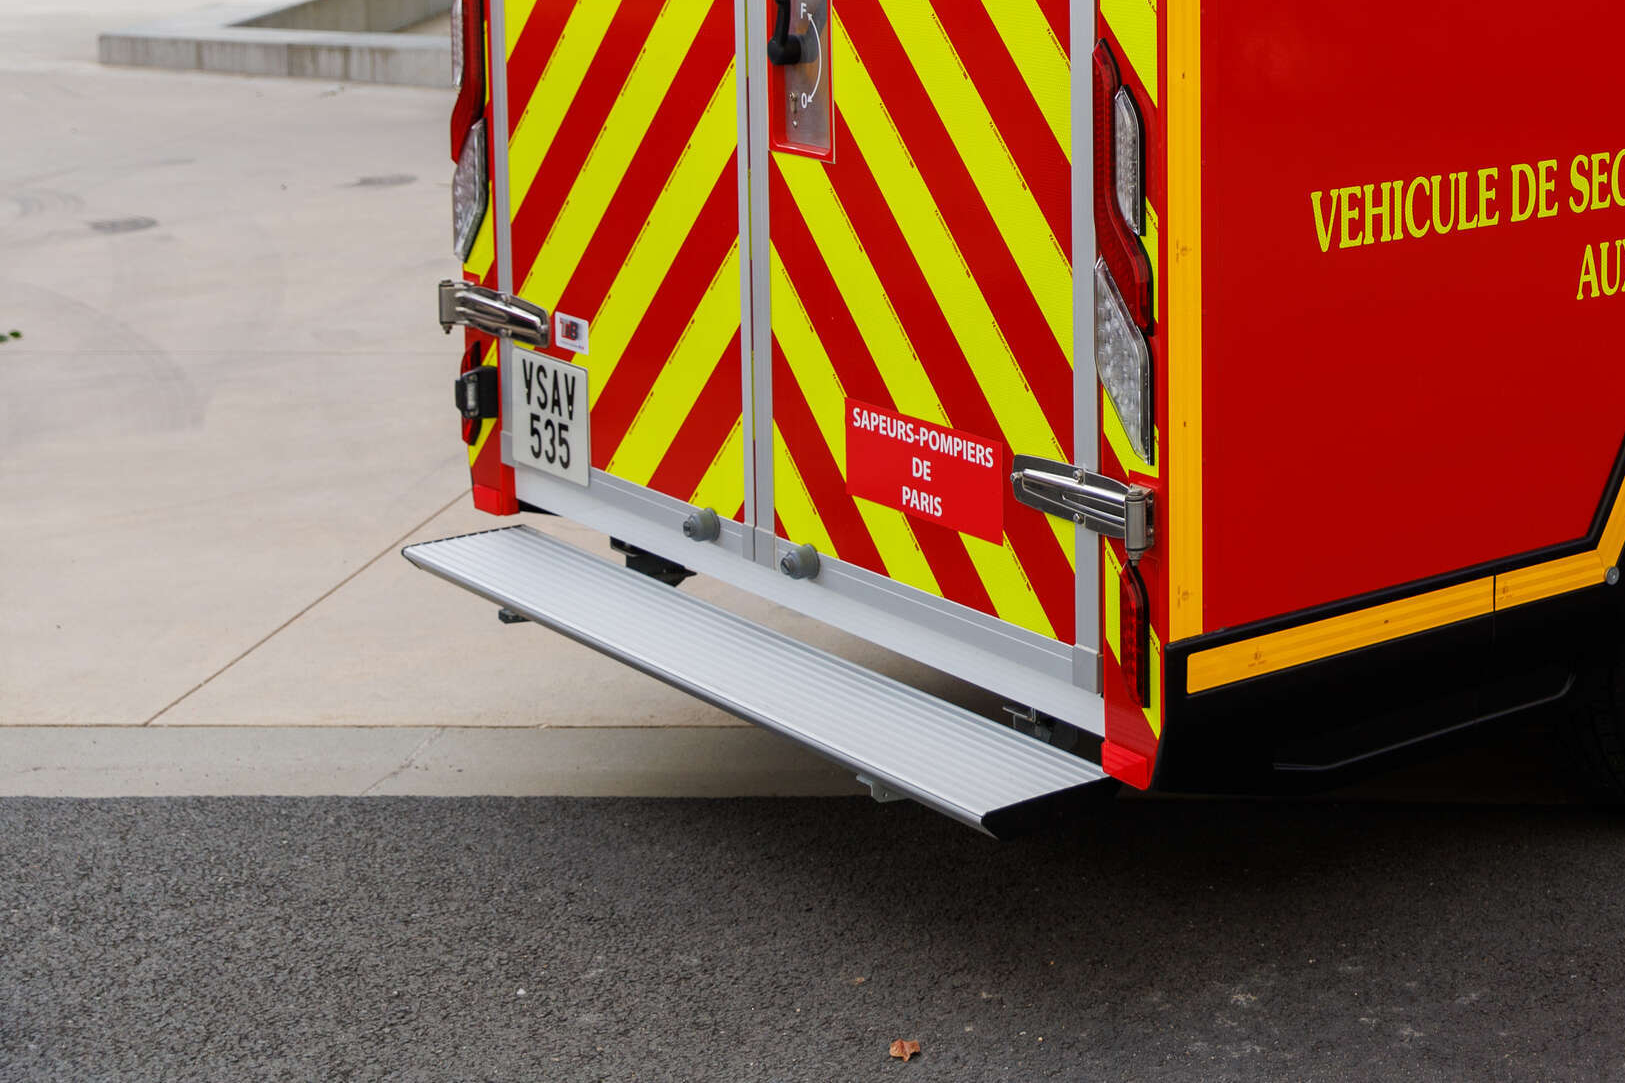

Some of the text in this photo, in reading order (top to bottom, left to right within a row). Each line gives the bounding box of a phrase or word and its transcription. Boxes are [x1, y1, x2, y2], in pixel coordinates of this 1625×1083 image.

[800, 2, 808, 20] F
[1310, 167, 1500, 253] VEHICULE
[1510, 159, 1559, 223] DE
[522, 358, 576, 421] VSAV
[530, 412, 571, 469] 535
[852, 407, 994, 468] SAPEURS-POMPIERS
[912, 456, 932, 482] DE
[902, 485, 943, 517] PARIS
